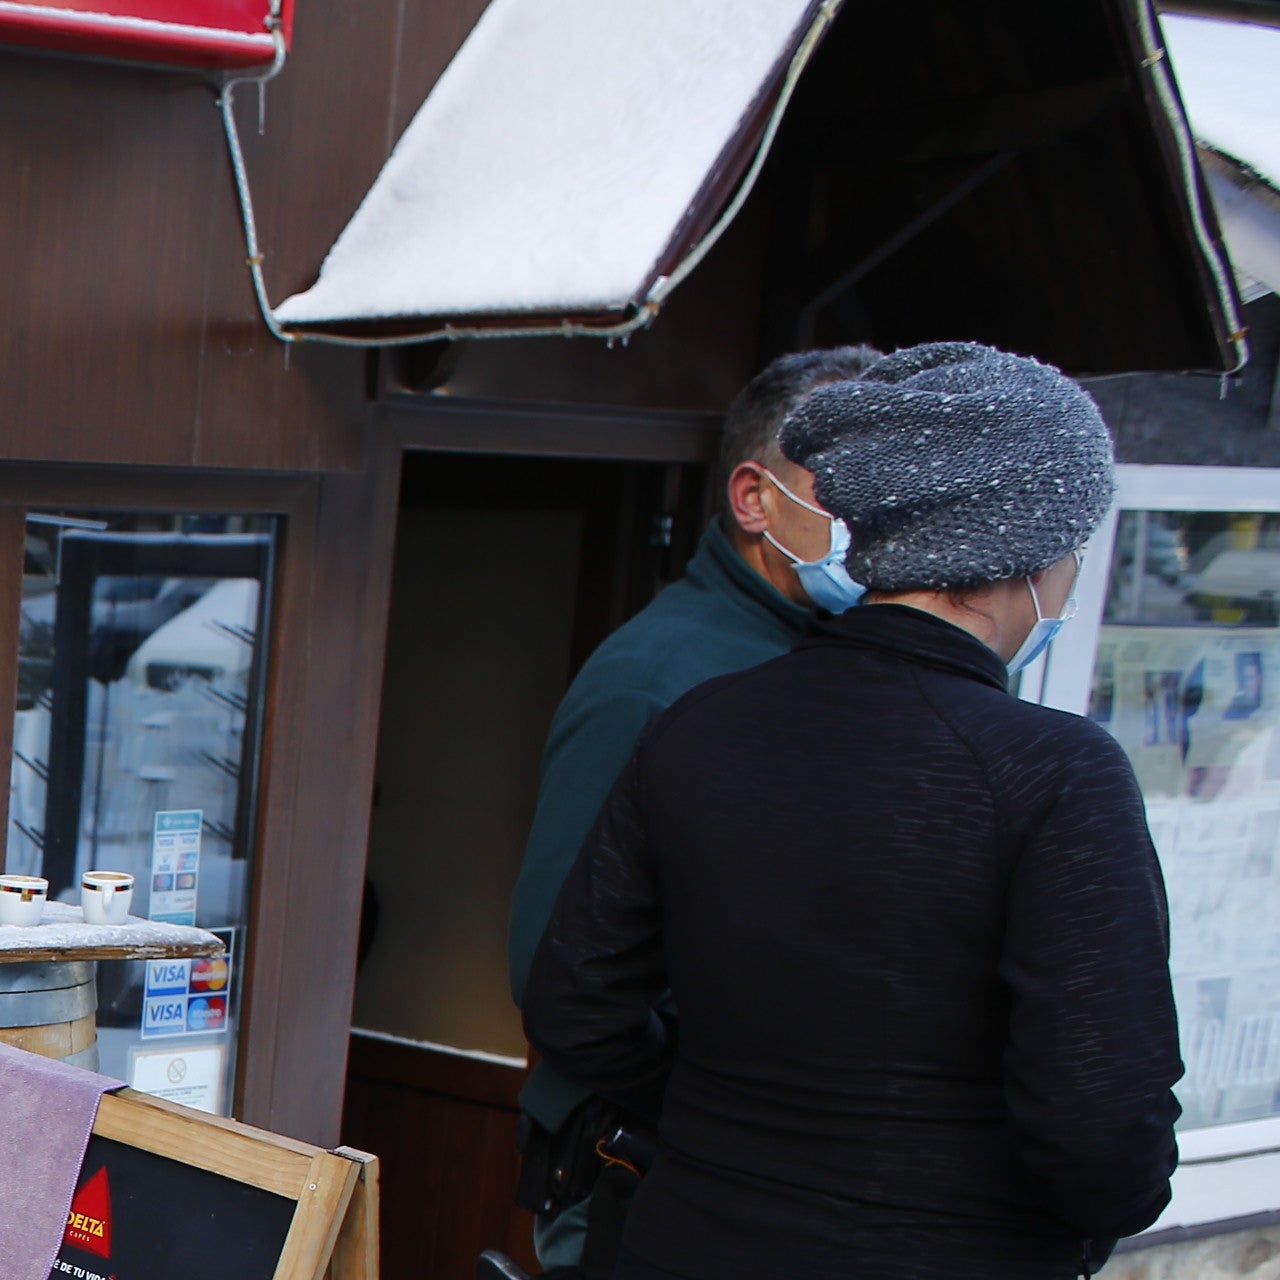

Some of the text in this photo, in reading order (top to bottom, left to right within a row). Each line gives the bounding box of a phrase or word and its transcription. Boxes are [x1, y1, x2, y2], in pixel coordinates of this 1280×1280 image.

[153, 965, 185, 983] VISA
[150, 1003, 182, 1021] VISA
[60, 1262, 73, 1274] DE
[72, 1266, 86, 1278] TU
